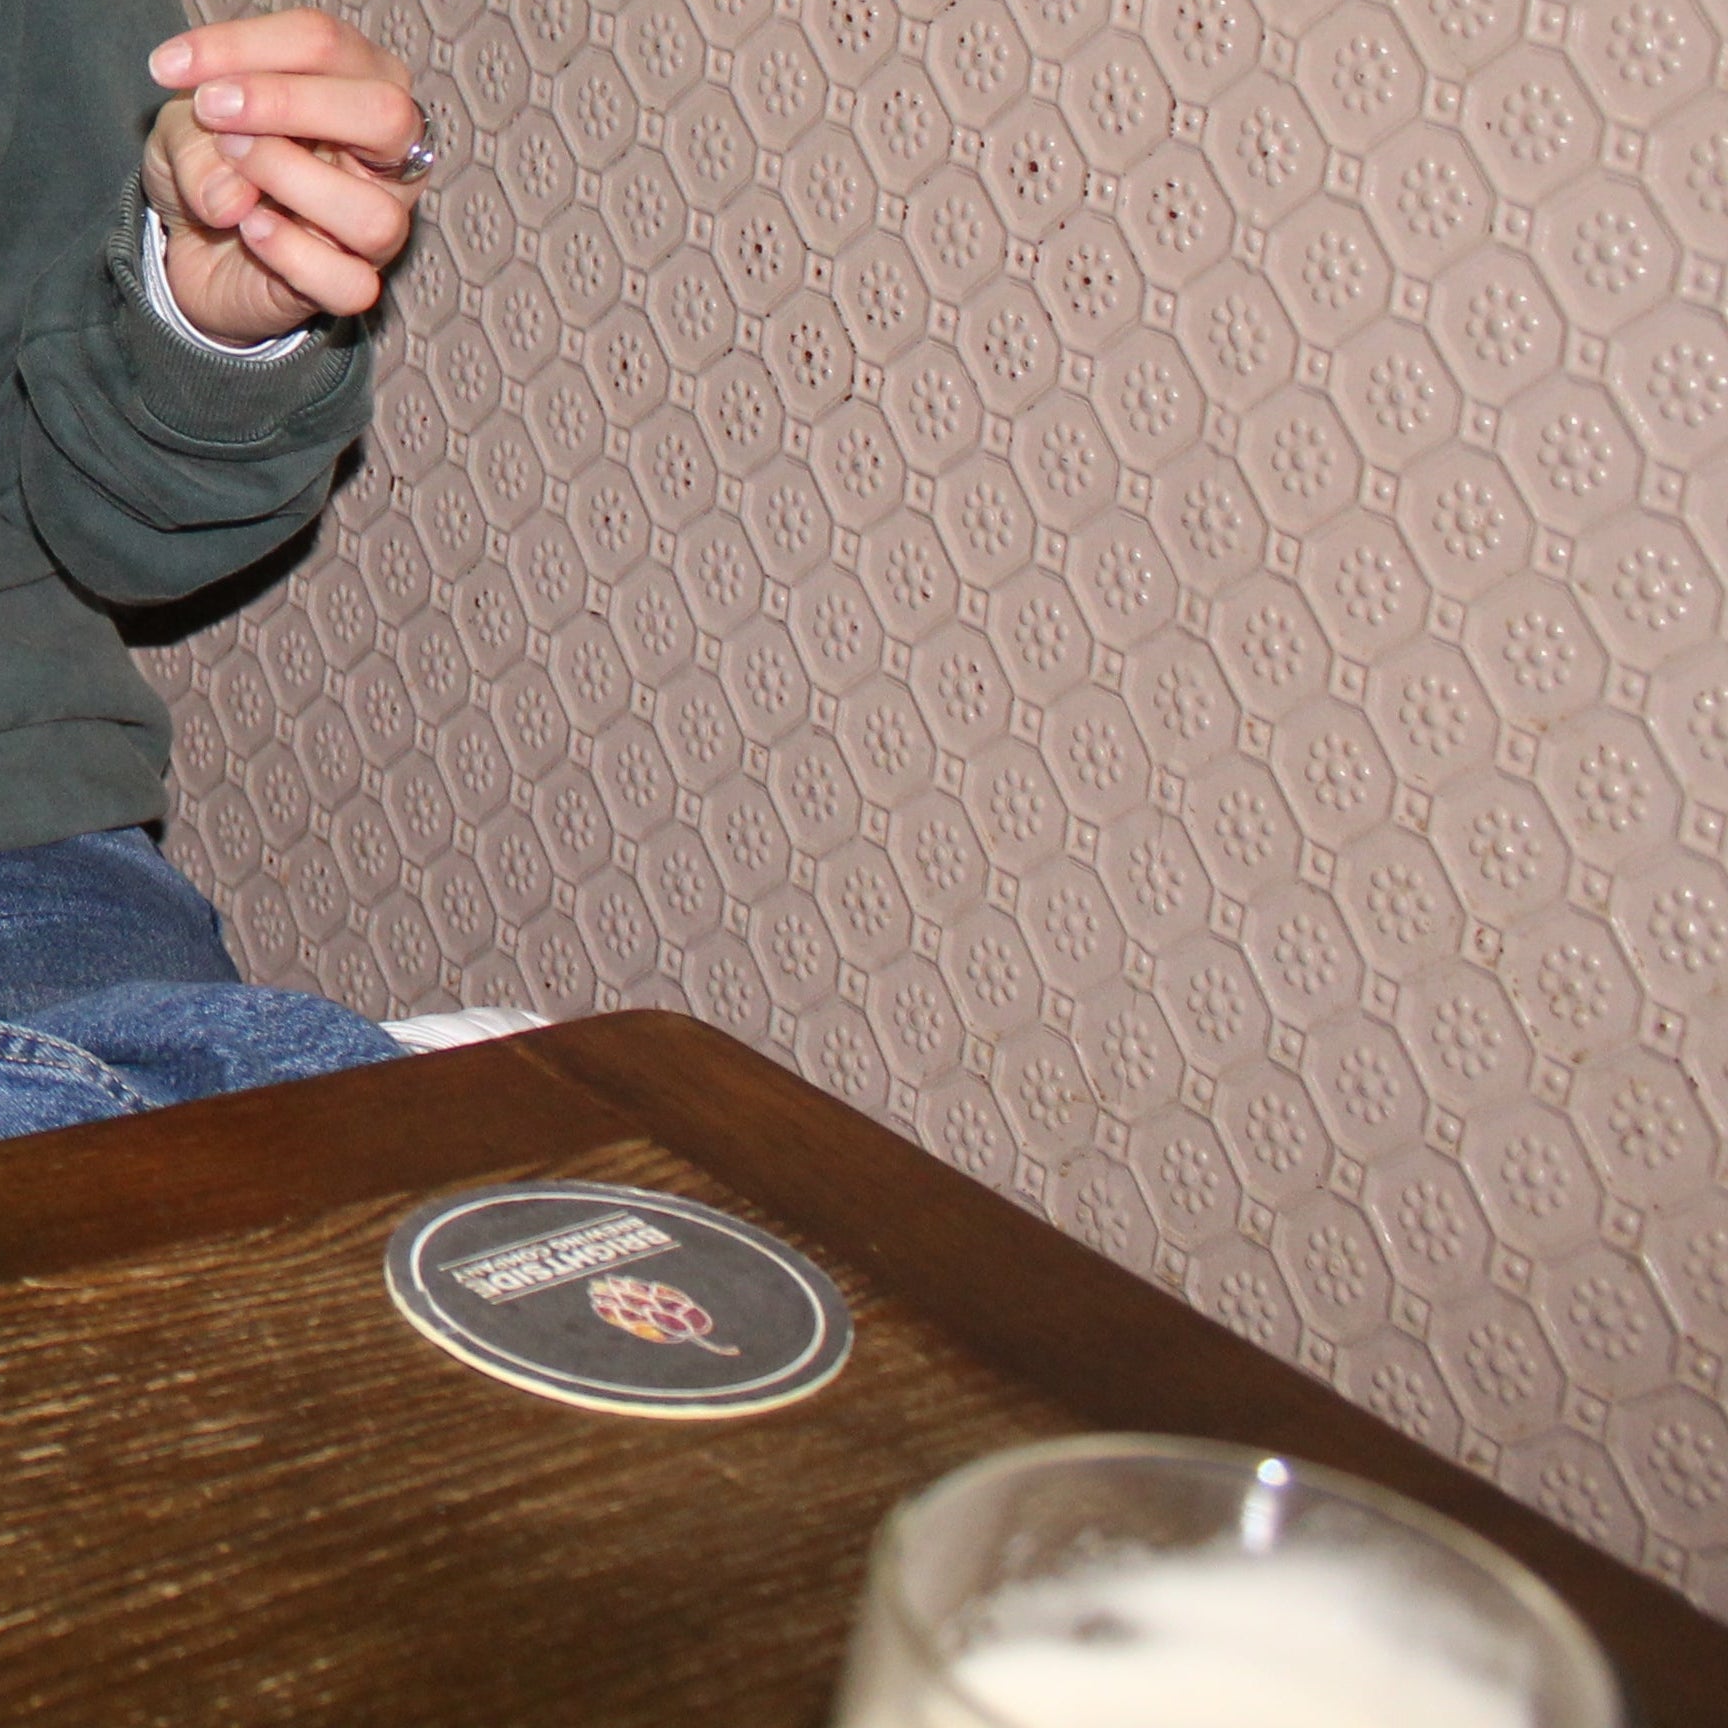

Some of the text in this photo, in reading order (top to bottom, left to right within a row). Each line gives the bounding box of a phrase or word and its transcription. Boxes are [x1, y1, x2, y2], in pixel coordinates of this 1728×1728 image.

[451, 1215, 646, 1284] BREWING COMPANY
[465, 1226, 672, 1300] BRIGHTSIDE
